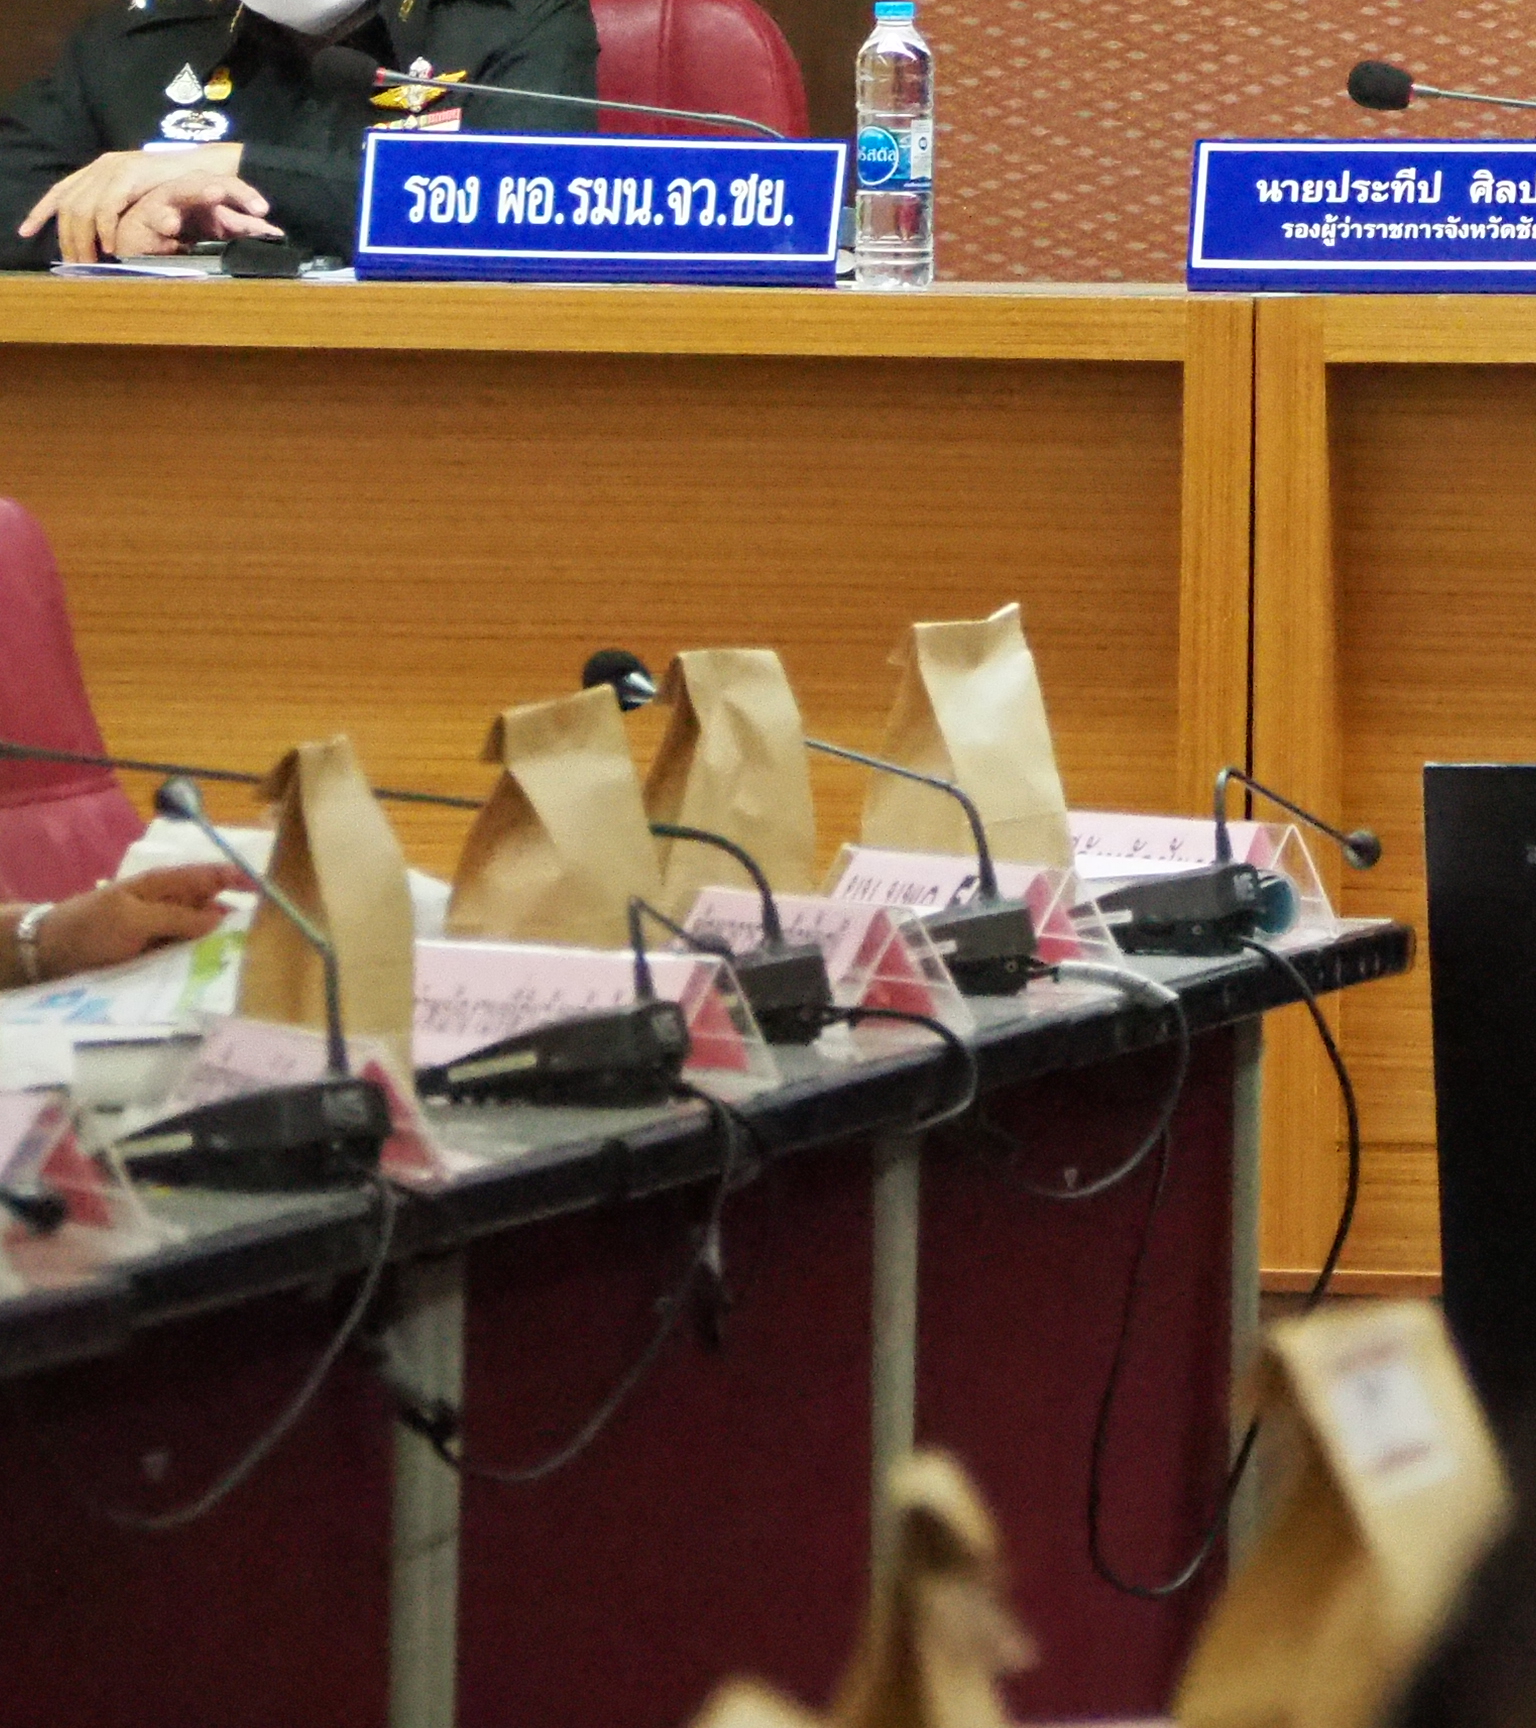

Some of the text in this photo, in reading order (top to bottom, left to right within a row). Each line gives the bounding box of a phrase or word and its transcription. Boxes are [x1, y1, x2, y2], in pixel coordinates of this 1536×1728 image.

[403, 173, 794, 227] รอง ผอ.รมน.จว.ชย.
[1255, 167, 1443, 204] นายประทีป
